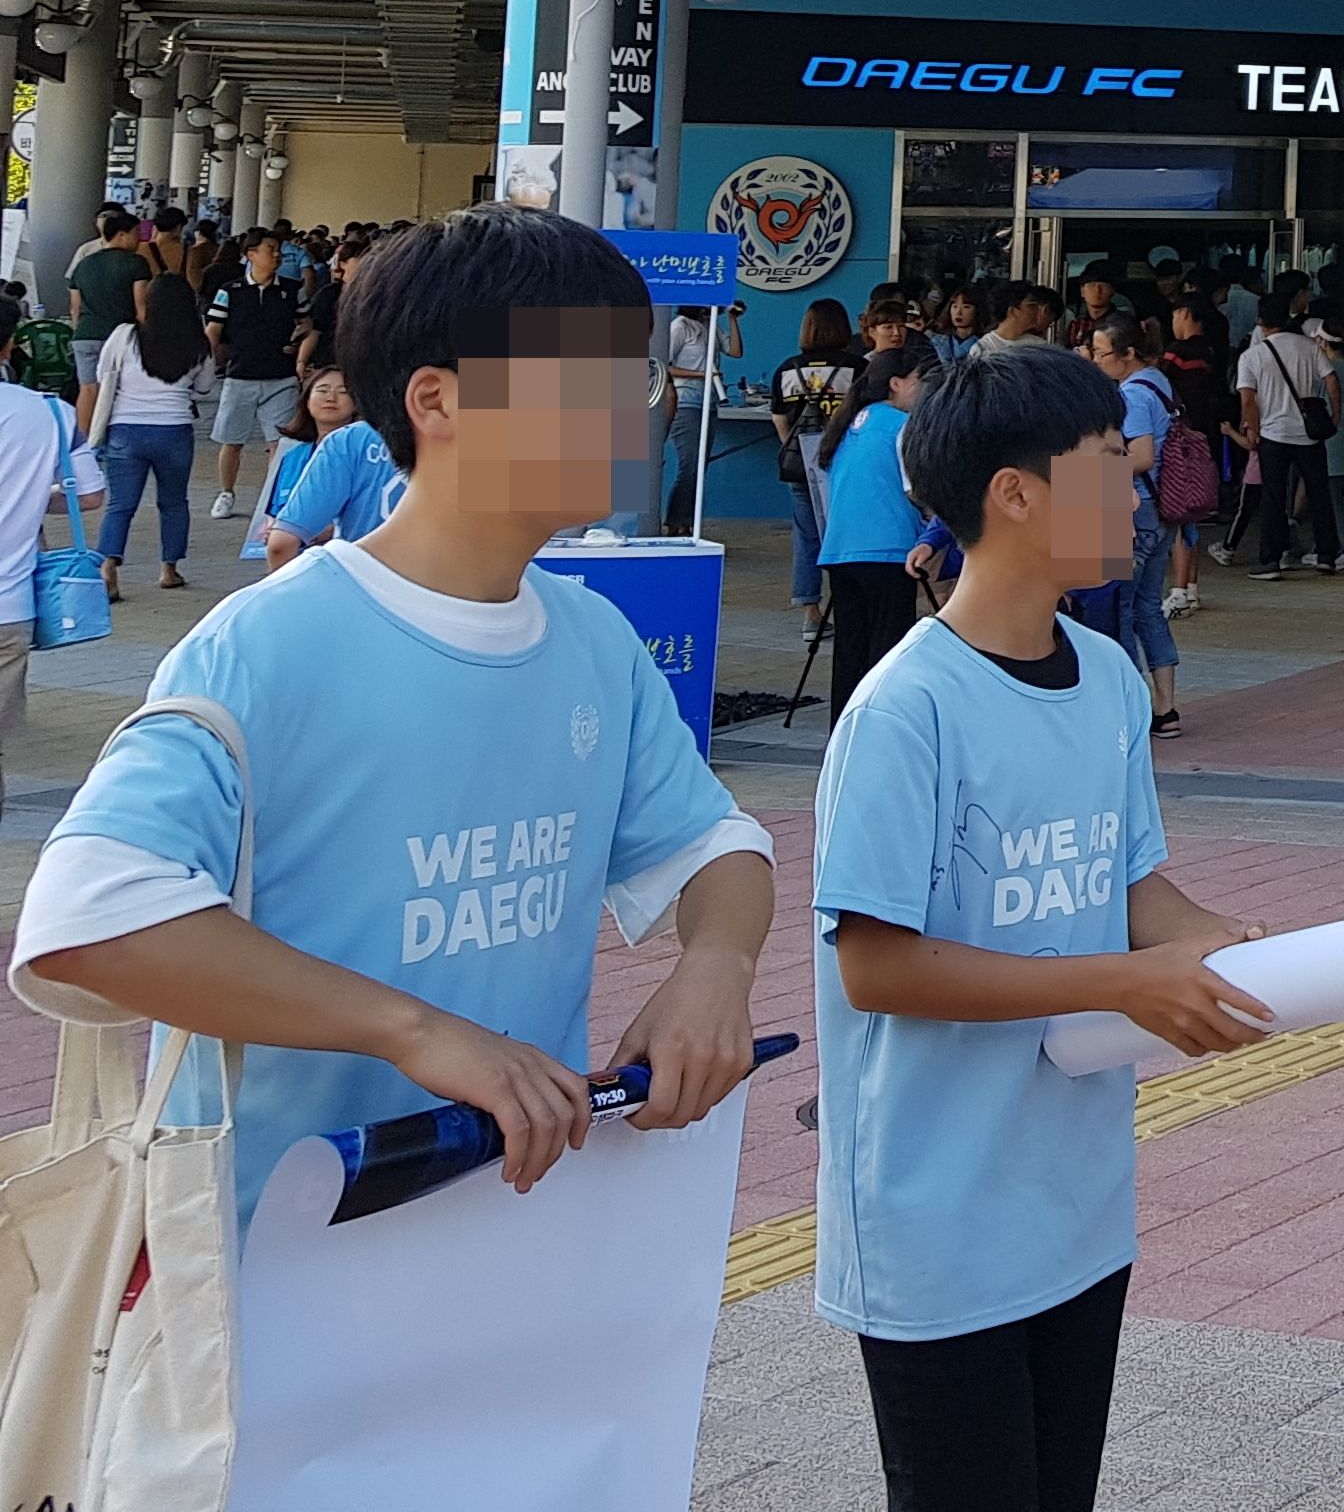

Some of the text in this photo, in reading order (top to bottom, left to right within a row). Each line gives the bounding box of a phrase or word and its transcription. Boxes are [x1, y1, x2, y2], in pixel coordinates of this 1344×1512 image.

[610, 46, 653, 67] WAY
[801, 55, 1068, 95] DAEGU
[1081, 68, 1186, 98] FC
[764, 173, 800, 183] 2002
[745, 267, 812, 277] DAEGU
[765, 276, 794, 284] FC
[406, 810, 577, 889] WE ARE
[1001, 818, 1080, 870] WE
[402, 869, 568, 965] DAEGU
